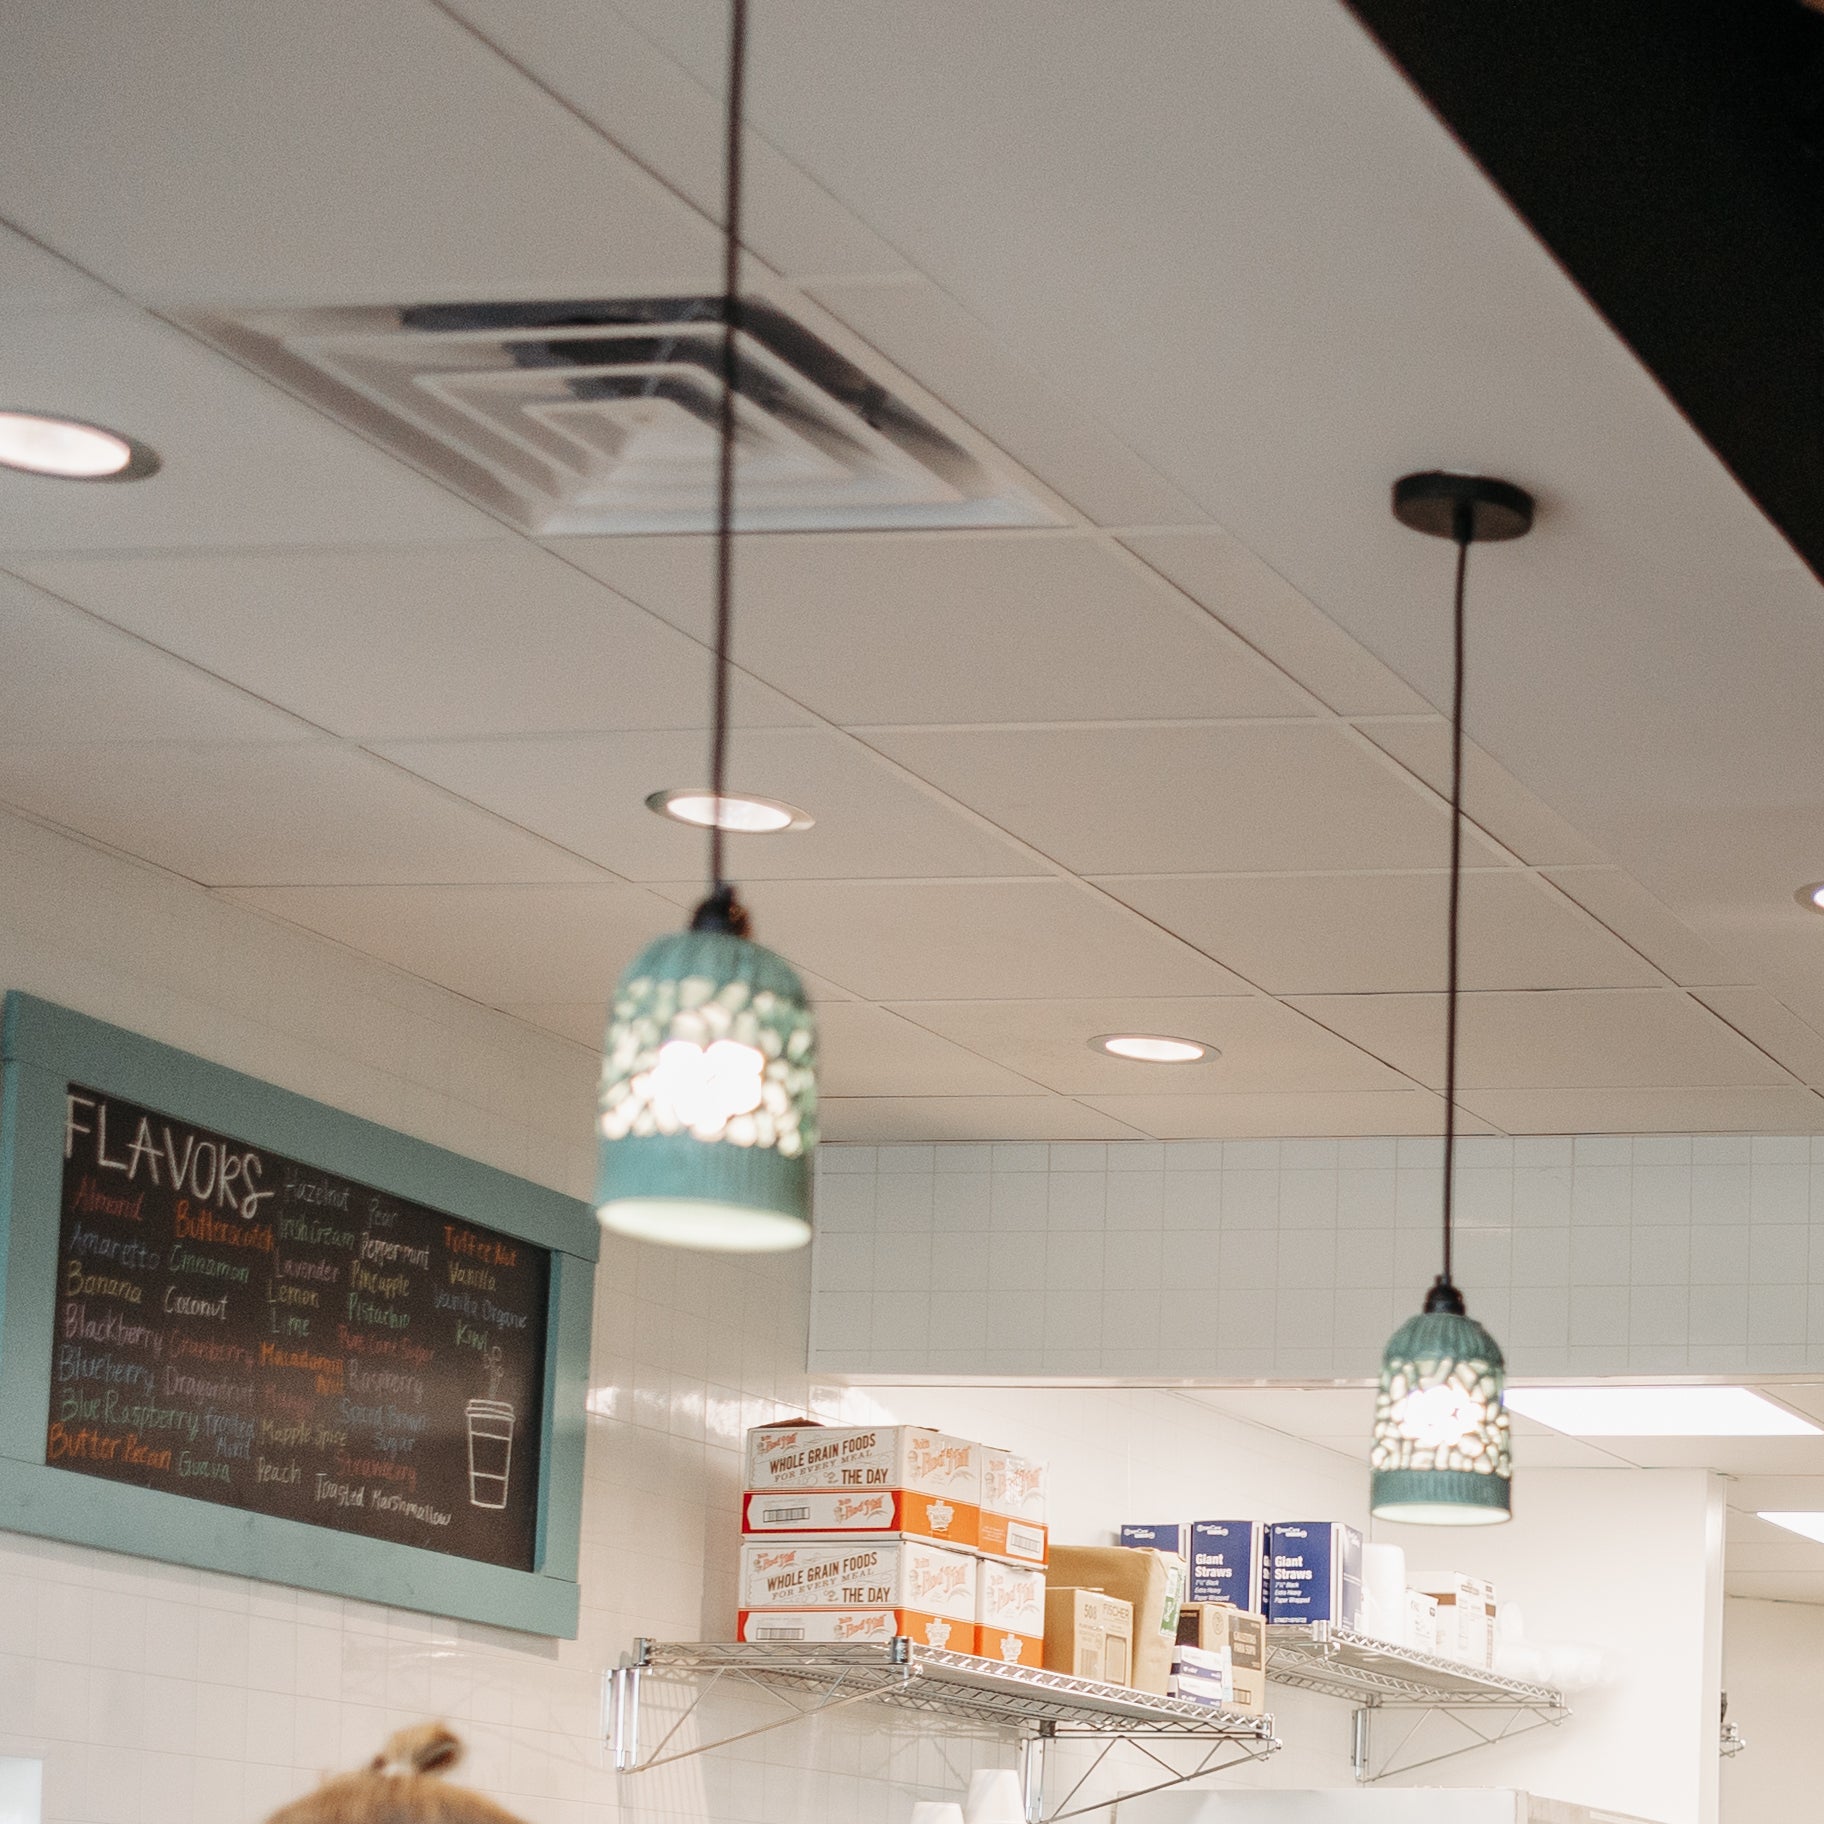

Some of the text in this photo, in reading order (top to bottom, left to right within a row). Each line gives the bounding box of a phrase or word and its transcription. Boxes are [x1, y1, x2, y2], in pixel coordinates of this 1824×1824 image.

[64, 1096, 275, 1219] FLAVORS
[64, 1260, 142, 1303] Banana
[770, 1432, 876, 1475] WHOLE GRAIN FOODS
[841, 1468, 888, 1485] THE DAY
[1195, 1553, 1224, 1566] Giant
[1274, 1555, 1303, 1568] Giant
[767, 1551, 878, 1592] WHOLE GRAIN FOODS
[1194, 1566, 1232, 1579] Straws
[1274, 1568, 1312, 1581] Straws
[842, 1587, 890, 1604] THE DAY
